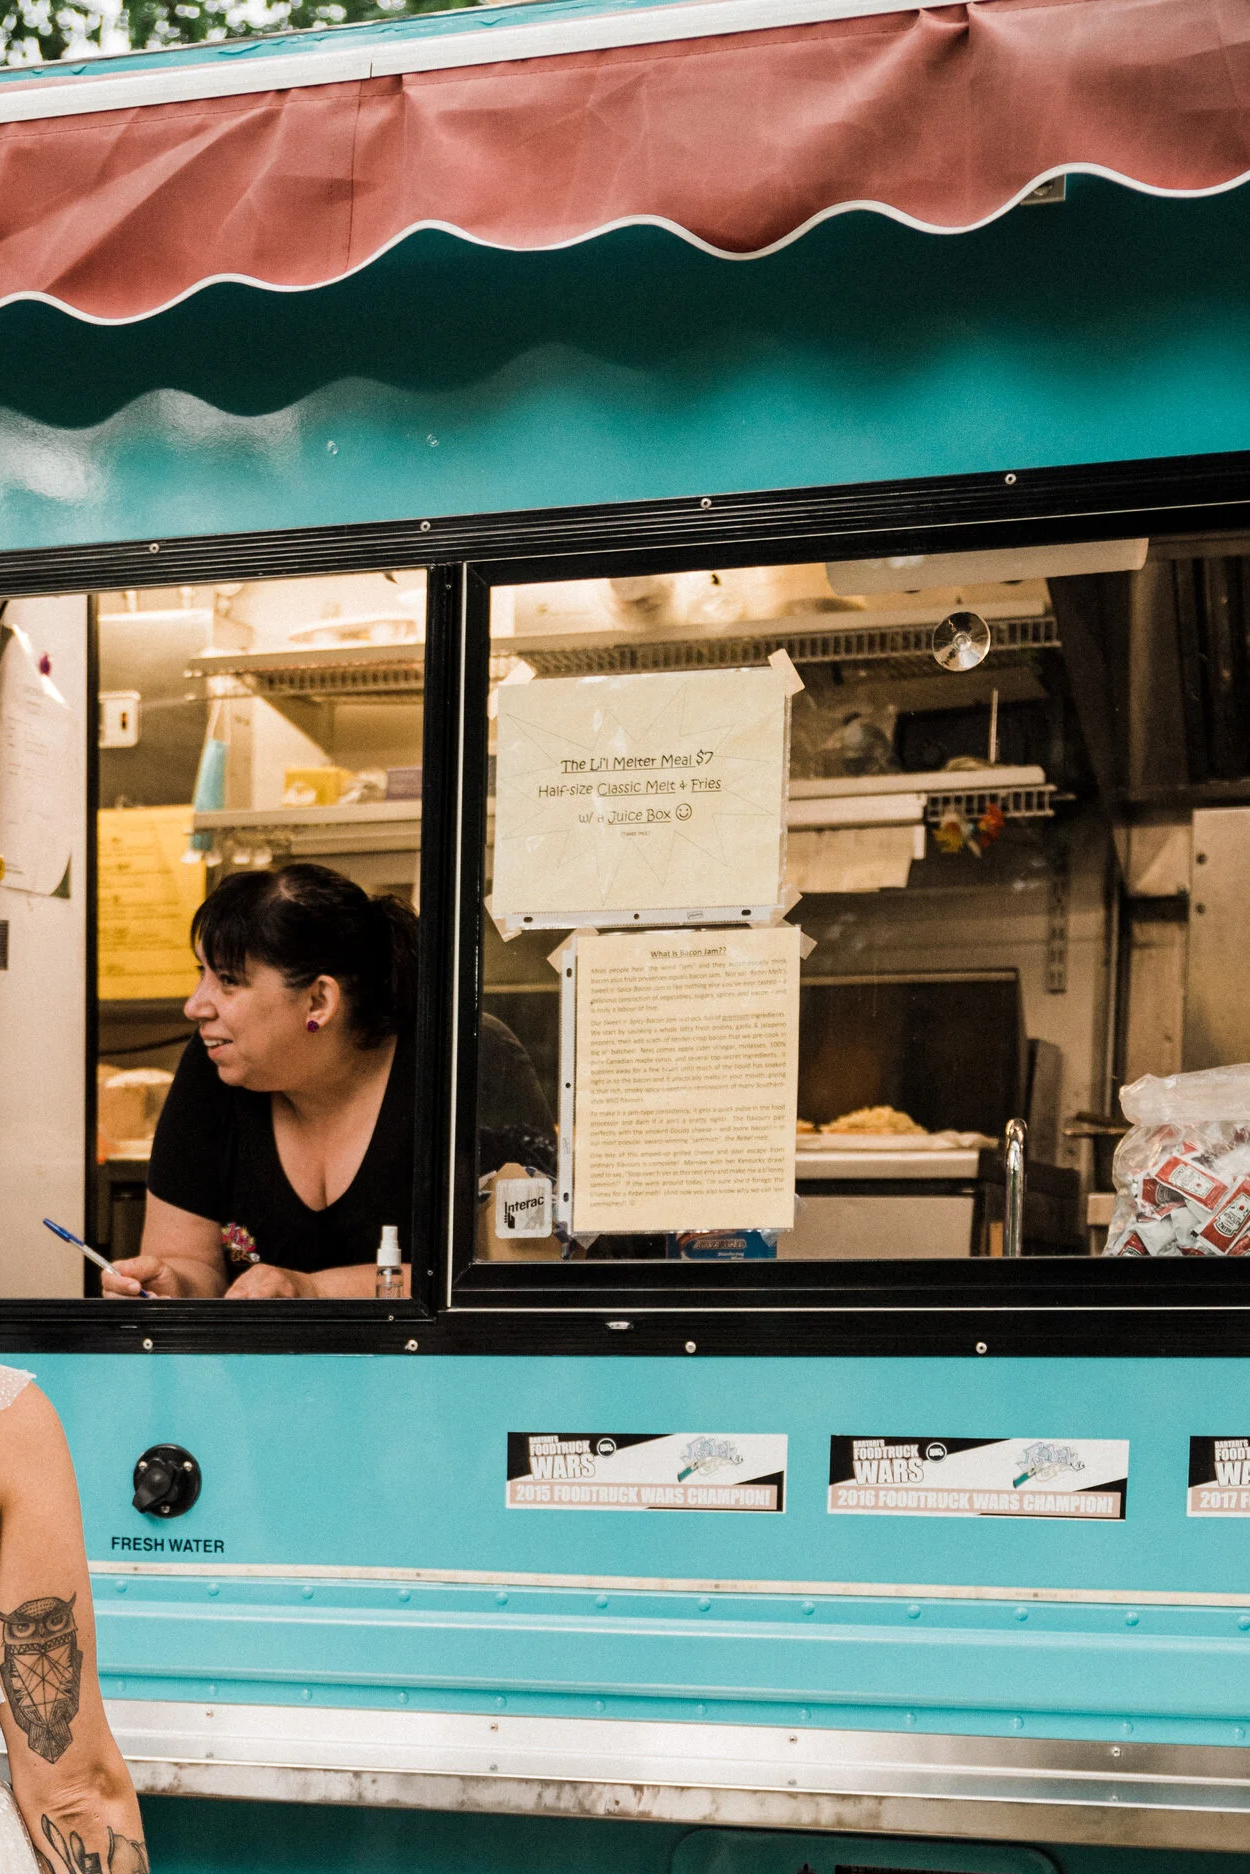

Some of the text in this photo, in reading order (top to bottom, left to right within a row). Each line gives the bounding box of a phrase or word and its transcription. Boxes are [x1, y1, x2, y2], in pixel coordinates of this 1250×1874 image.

[561, 749, 714, 772] The Li'l Melter Meal $7
[538, 782, 593, 798] Half-size
[597, 780, 641, 797] Classic
[646, 779, 675, 795] Melt
[691, 777, 722, 793] Fries
[578, 812, 594, 824] w/
[607, 809, 643, 824] Juice
[646, 807, 671, 822] Box
[650, 950, 671, 960] What
[503, 1196, 545, 1215] Interac
[530, 1440, 591, 1456] FOODTRUCK
[854, 1444, 919, 1460] FOODTRUCK
[530, 1453, 596, 1480] WARS
[854, 1458, 924, 1485] WARS
[517, 1484, 771, 1507] 2015 FOODTRUCK WARS CHAMPION!
[837, 1489, 1114, 1514] 2016 FOODTRUCK WARS CHAMPION!
[1199, 1491, 1238, 1509] 2017
[111, 1536, 225, 1553] FRESH WATER
